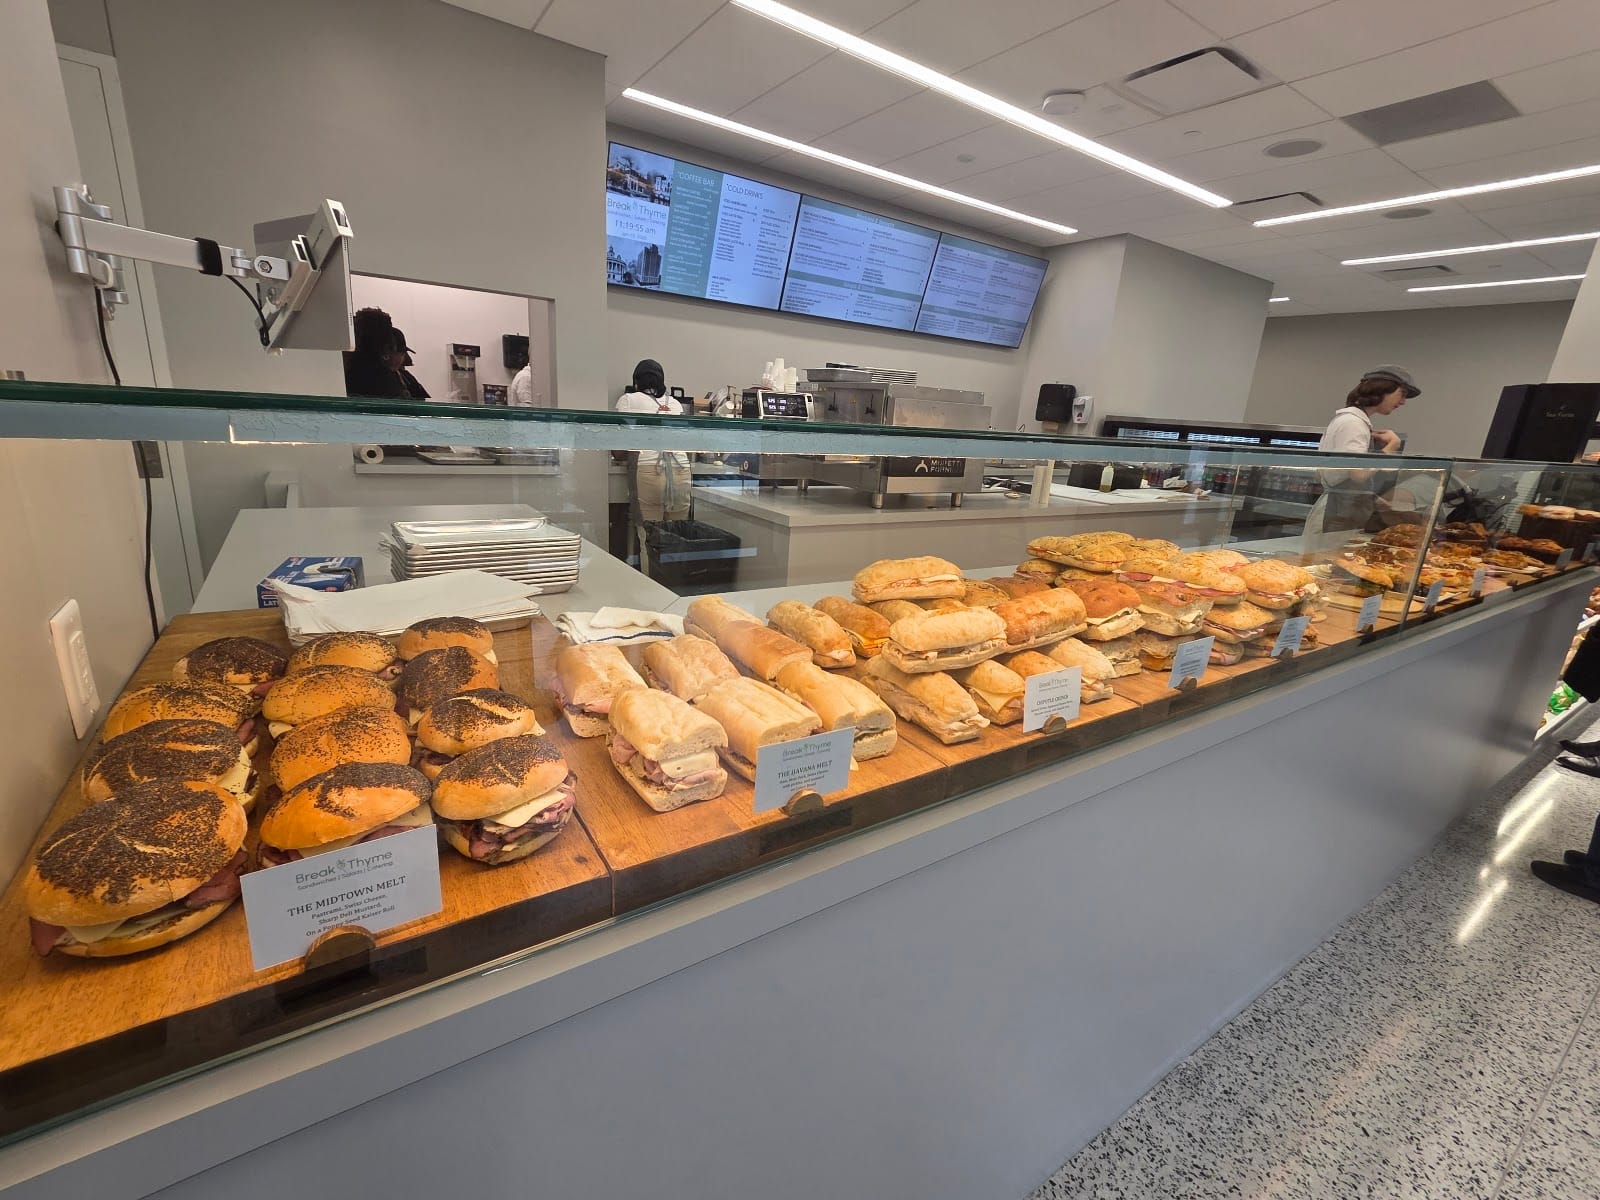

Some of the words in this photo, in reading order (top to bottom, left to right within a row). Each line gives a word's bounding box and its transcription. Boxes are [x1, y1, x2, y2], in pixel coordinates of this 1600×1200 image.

[607, 197, 631, 211] Break
[640, 205, 667, 219] Thyme
[778, 770, 790, 779] THE
[816, 760, 833, 769] MELT
[295, 865, 336, 884] Break
[347, 851, 393, 870] Thyme
[286, 902, 313, 917] THE
[315, 885, 374, 909] MIDTOWN
[376, 875, 407, 892] MELT
[305, 929, 316, 937] On
